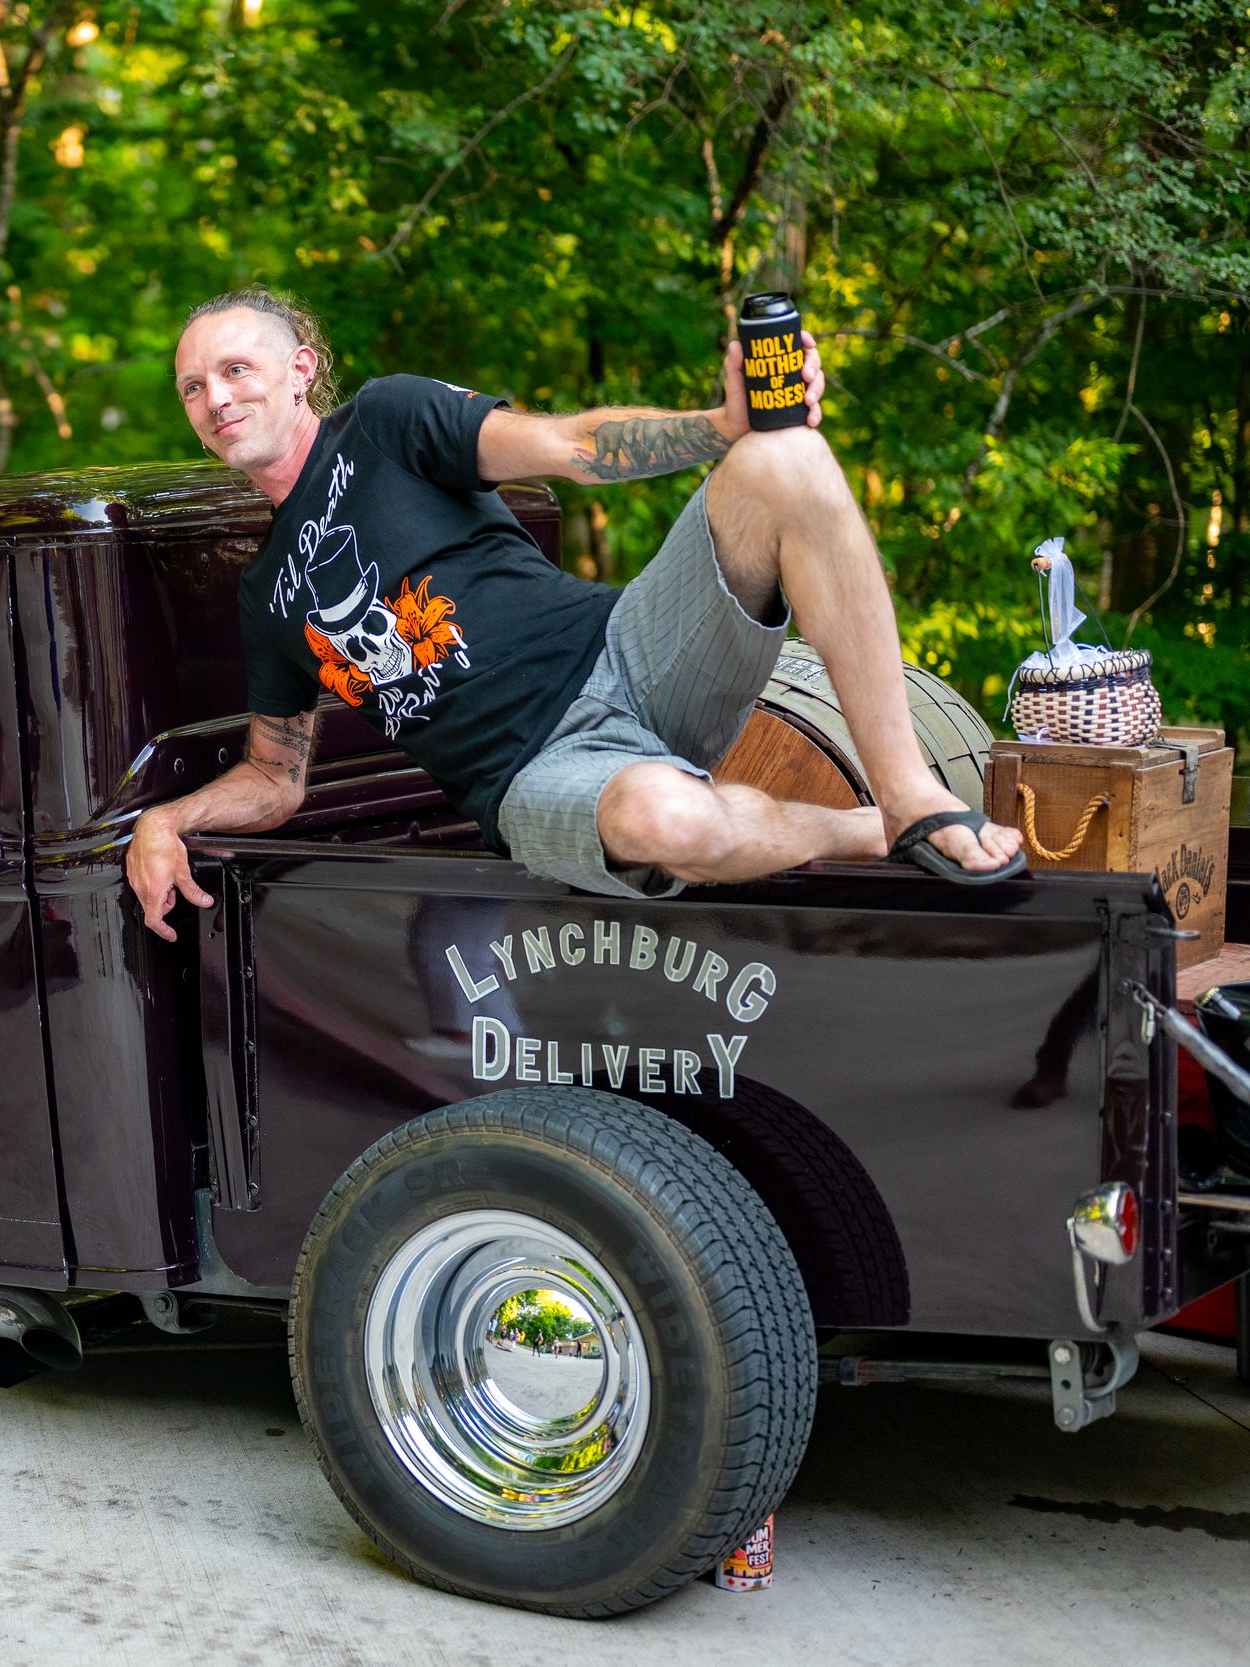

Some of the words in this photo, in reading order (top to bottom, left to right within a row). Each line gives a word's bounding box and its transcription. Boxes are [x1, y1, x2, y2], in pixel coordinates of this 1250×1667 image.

[751, 333, 794, 358] HOLY
[744, 349, 804, 378] MOTHER
[770, 375, 785, 389] OF
[298, 452, 354, 563] Death
[472, 1015, 748, 1099] DELIVERY
[746, 1541, 770, 1555] MER
[748, 1552, 769, 1566] FEST
